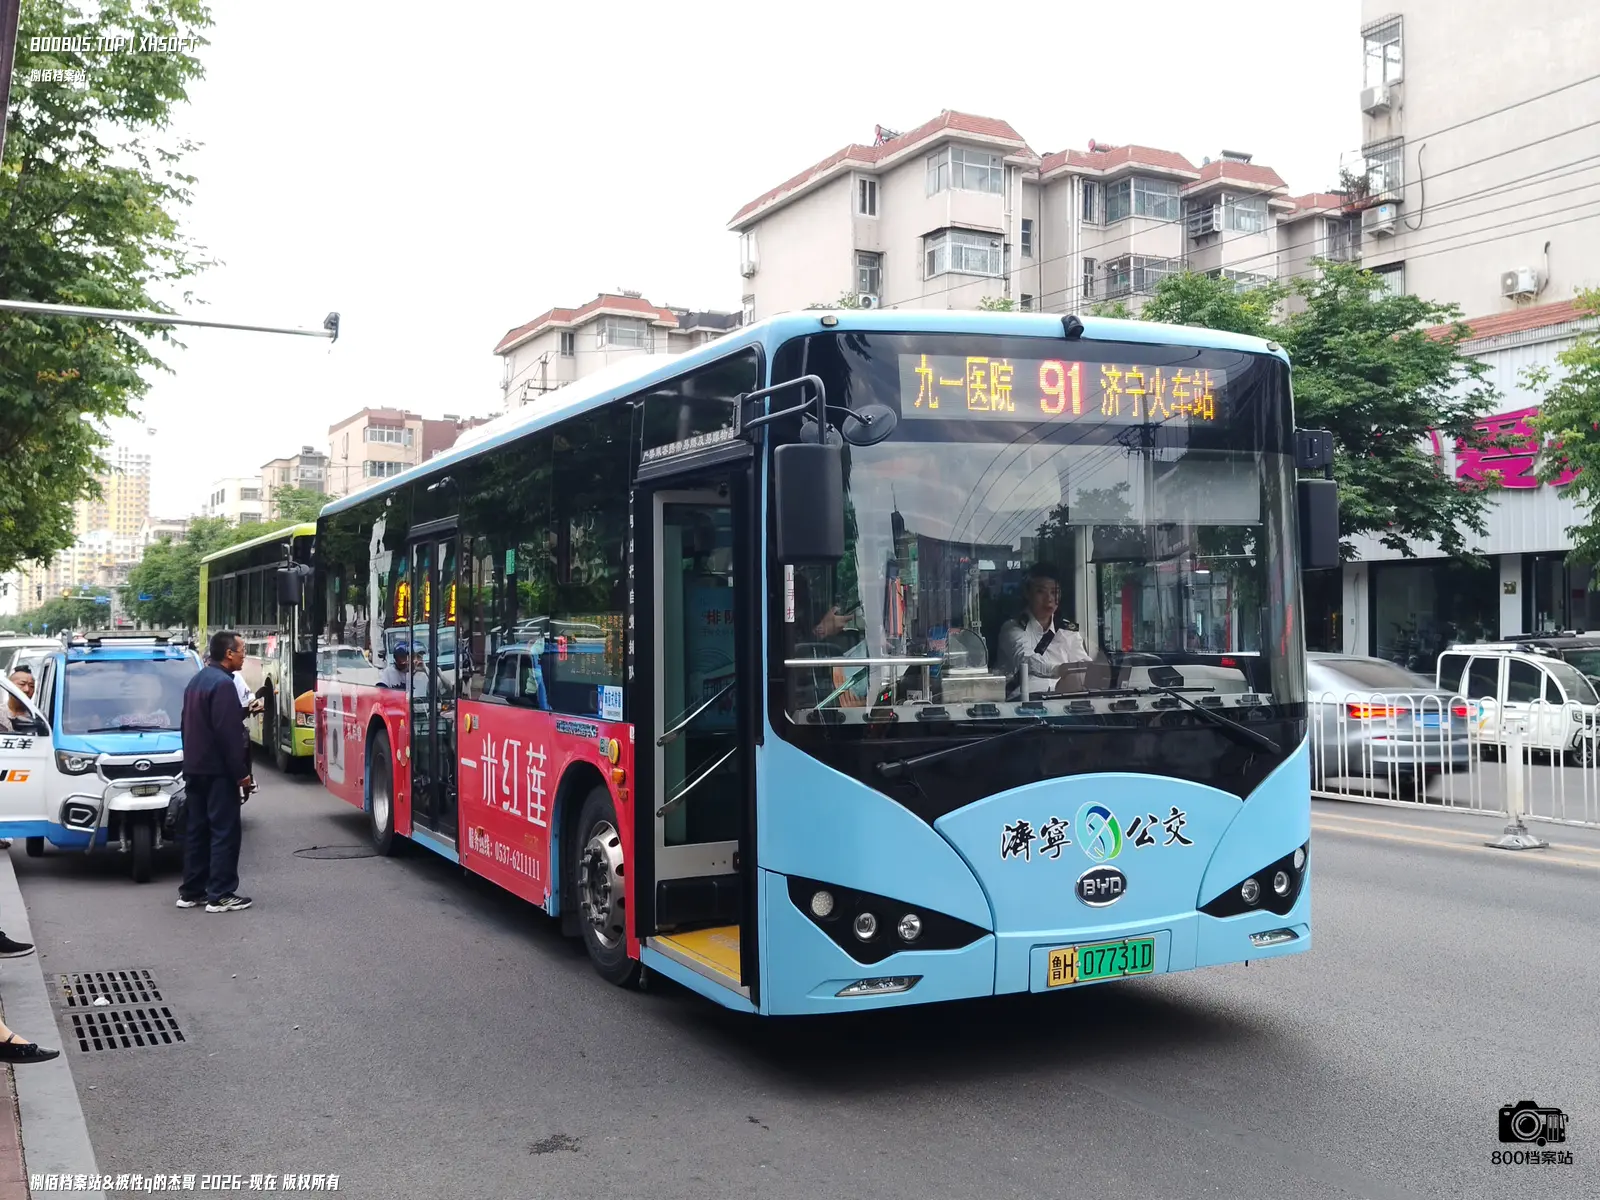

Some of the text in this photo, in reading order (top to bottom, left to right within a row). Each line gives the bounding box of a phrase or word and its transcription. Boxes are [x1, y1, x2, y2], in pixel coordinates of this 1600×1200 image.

[914, 354, 1215, 420] 九一医院 91 济宁火车站
[1, 737, 34, 750] 五羊
[460, 732, 547, 828] 一米红莲
[1126, 806, 1195, 848] 公交
[1082, 876, 1122, 896] BYD
[1051, 942, 1152, 981] 鲁H 07731D
